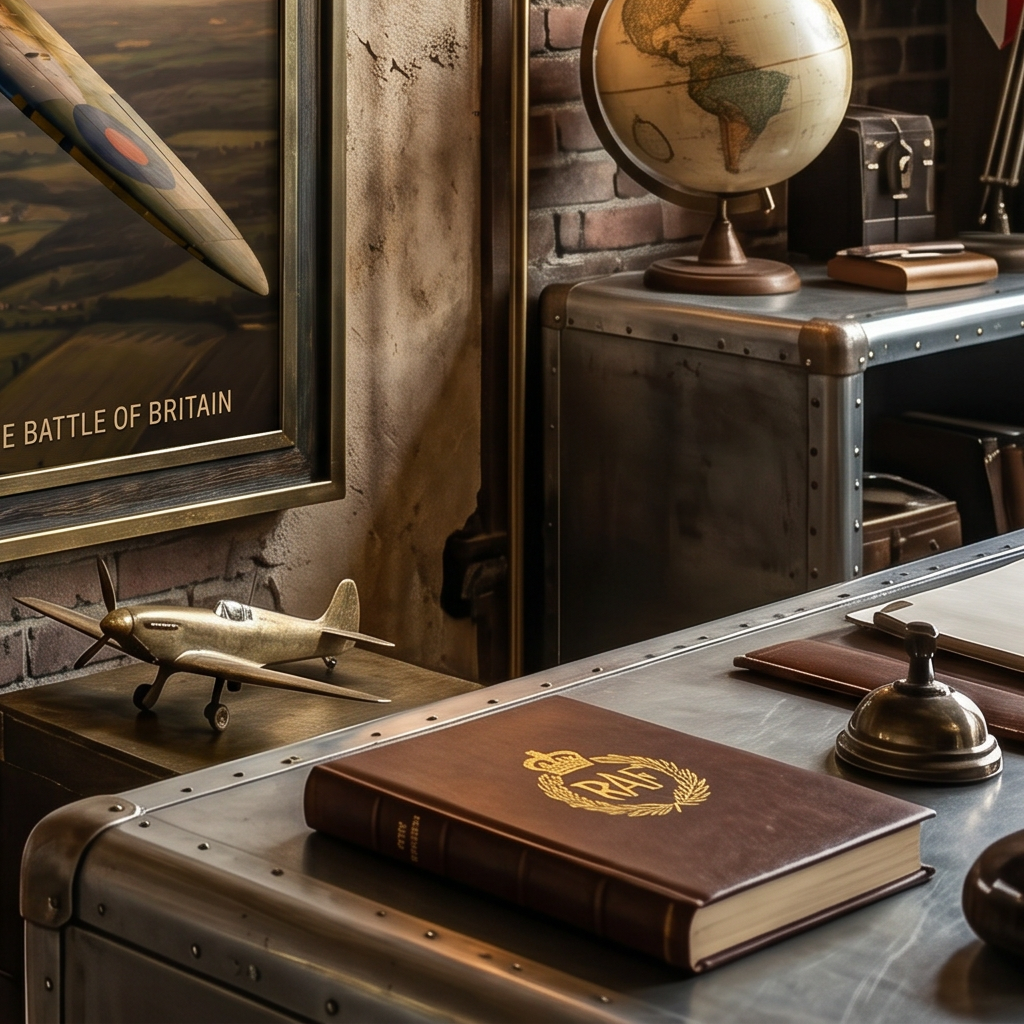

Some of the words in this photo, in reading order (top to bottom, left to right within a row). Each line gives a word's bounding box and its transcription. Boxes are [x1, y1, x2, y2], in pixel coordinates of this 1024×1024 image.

[23, 408, 107, 444] BATTLE
[114, 403, 141, 430] OF
[148, 389, 232, 426] BRITAIN
[570, 764, 664, 801] RAF
